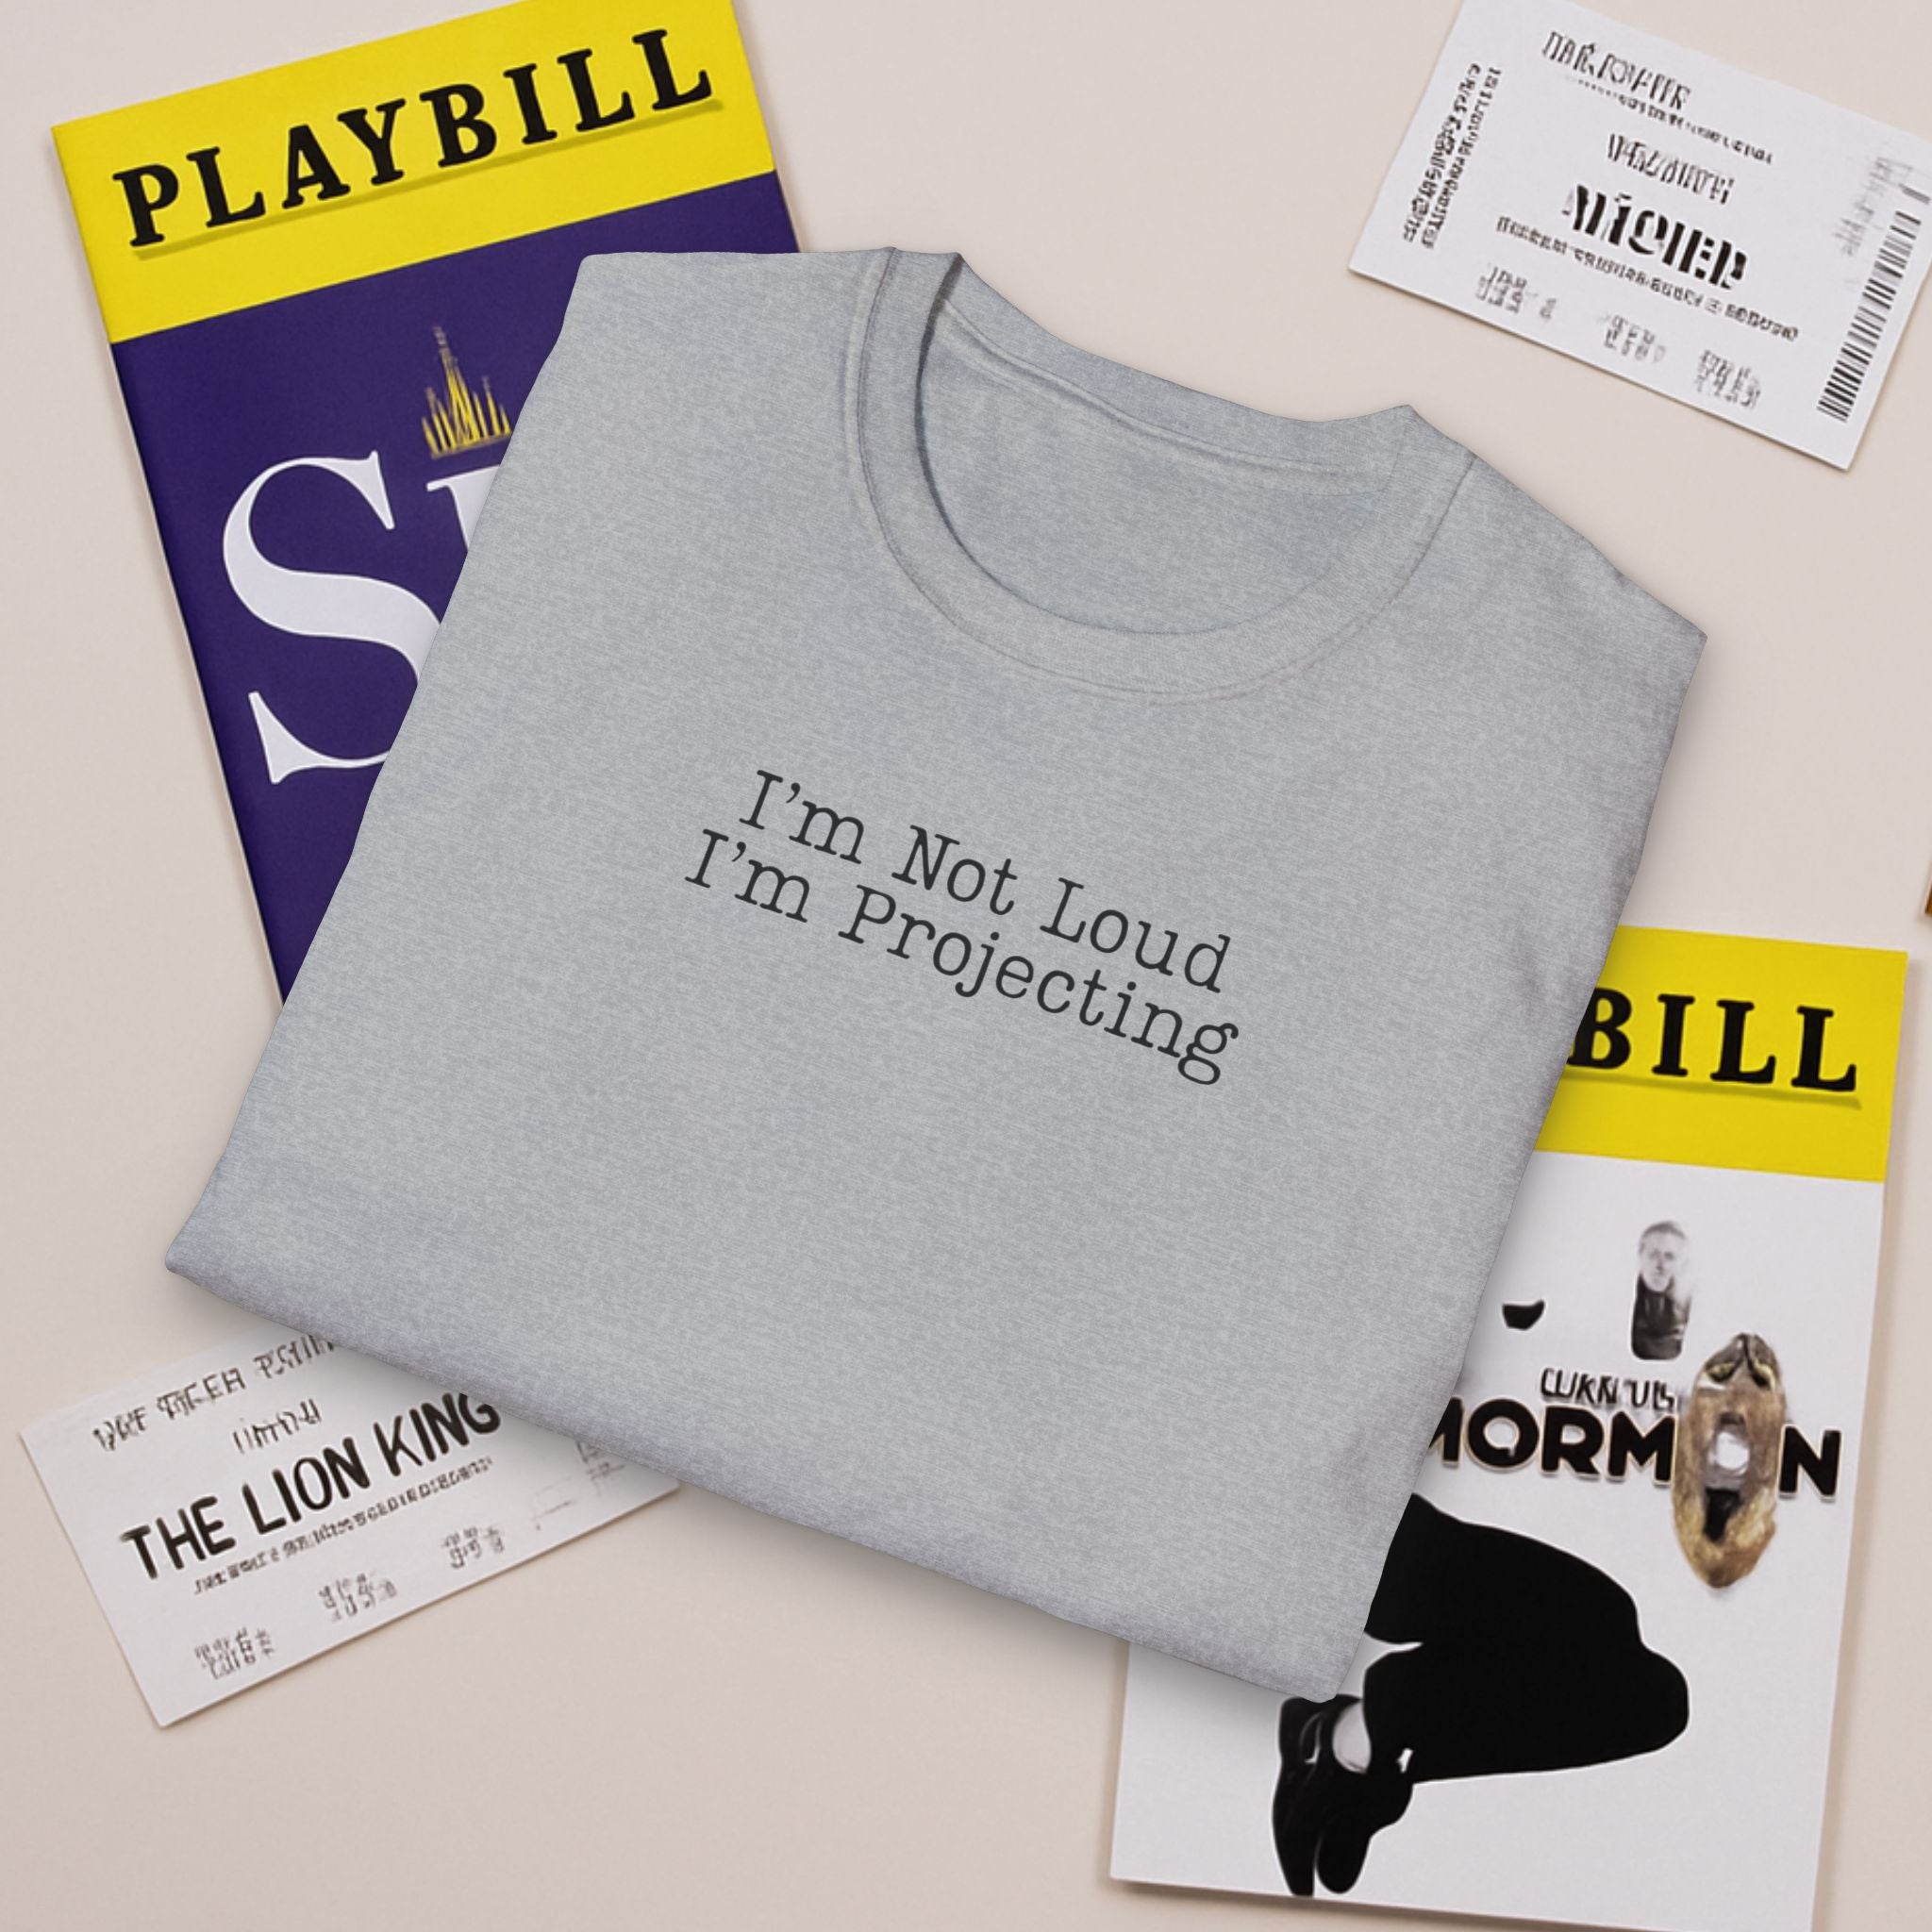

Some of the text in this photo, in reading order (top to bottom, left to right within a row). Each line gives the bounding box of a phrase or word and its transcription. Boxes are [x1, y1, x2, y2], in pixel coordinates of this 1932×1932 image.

[111, 28, 712, 248] PLAYBILL
[683, 827, 1241, 1086] I’m Projecting
[739, 769, 1232, 993] I’m Not Loud
[120, 1495, 237, 1579] THE
[242, 1437, 372, 1536] LION
[373, 1391, 501, 1477] KING
